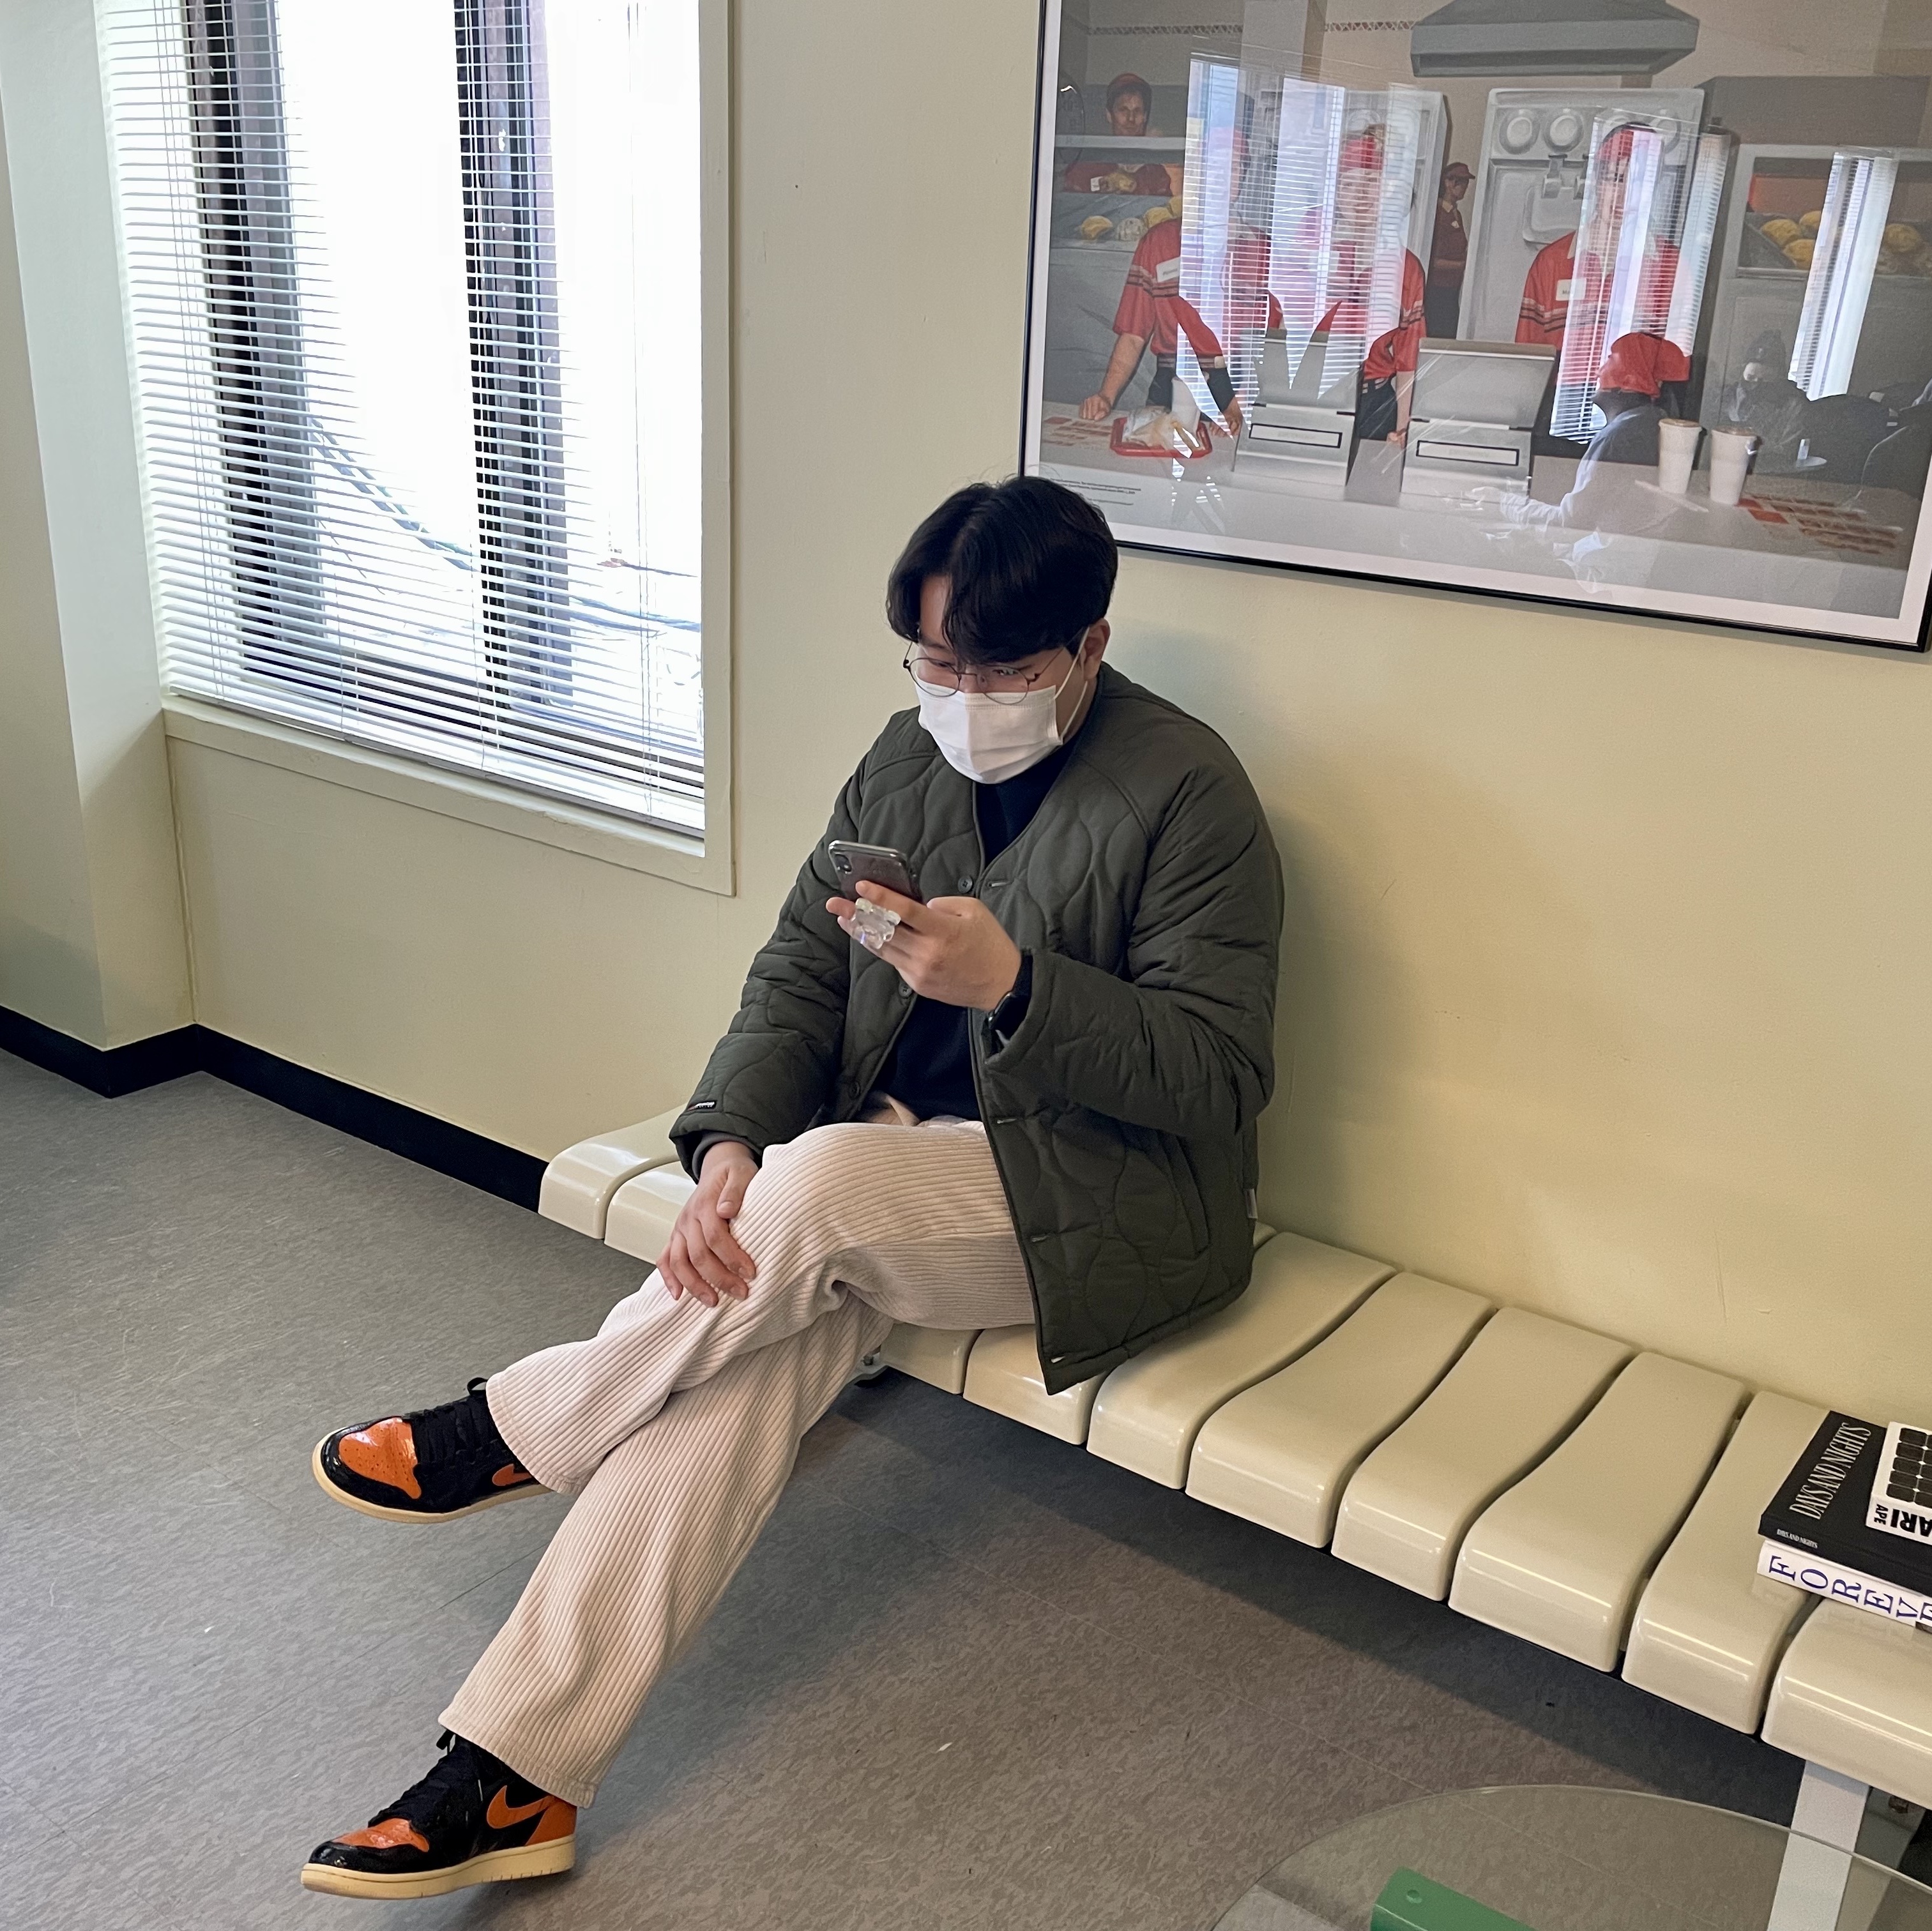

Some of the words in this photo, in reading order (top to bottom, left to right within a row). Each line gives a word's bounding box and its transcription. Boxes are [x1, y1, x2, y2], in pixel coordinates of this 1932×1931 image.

[1821, 1422, 1871, 1469] NIGHTS
[1807, 1464, 1846, 1494] AND
[1789, 1485, 1833, 1520] DAYS
[1874, 1504, 1889, 1525] APE
